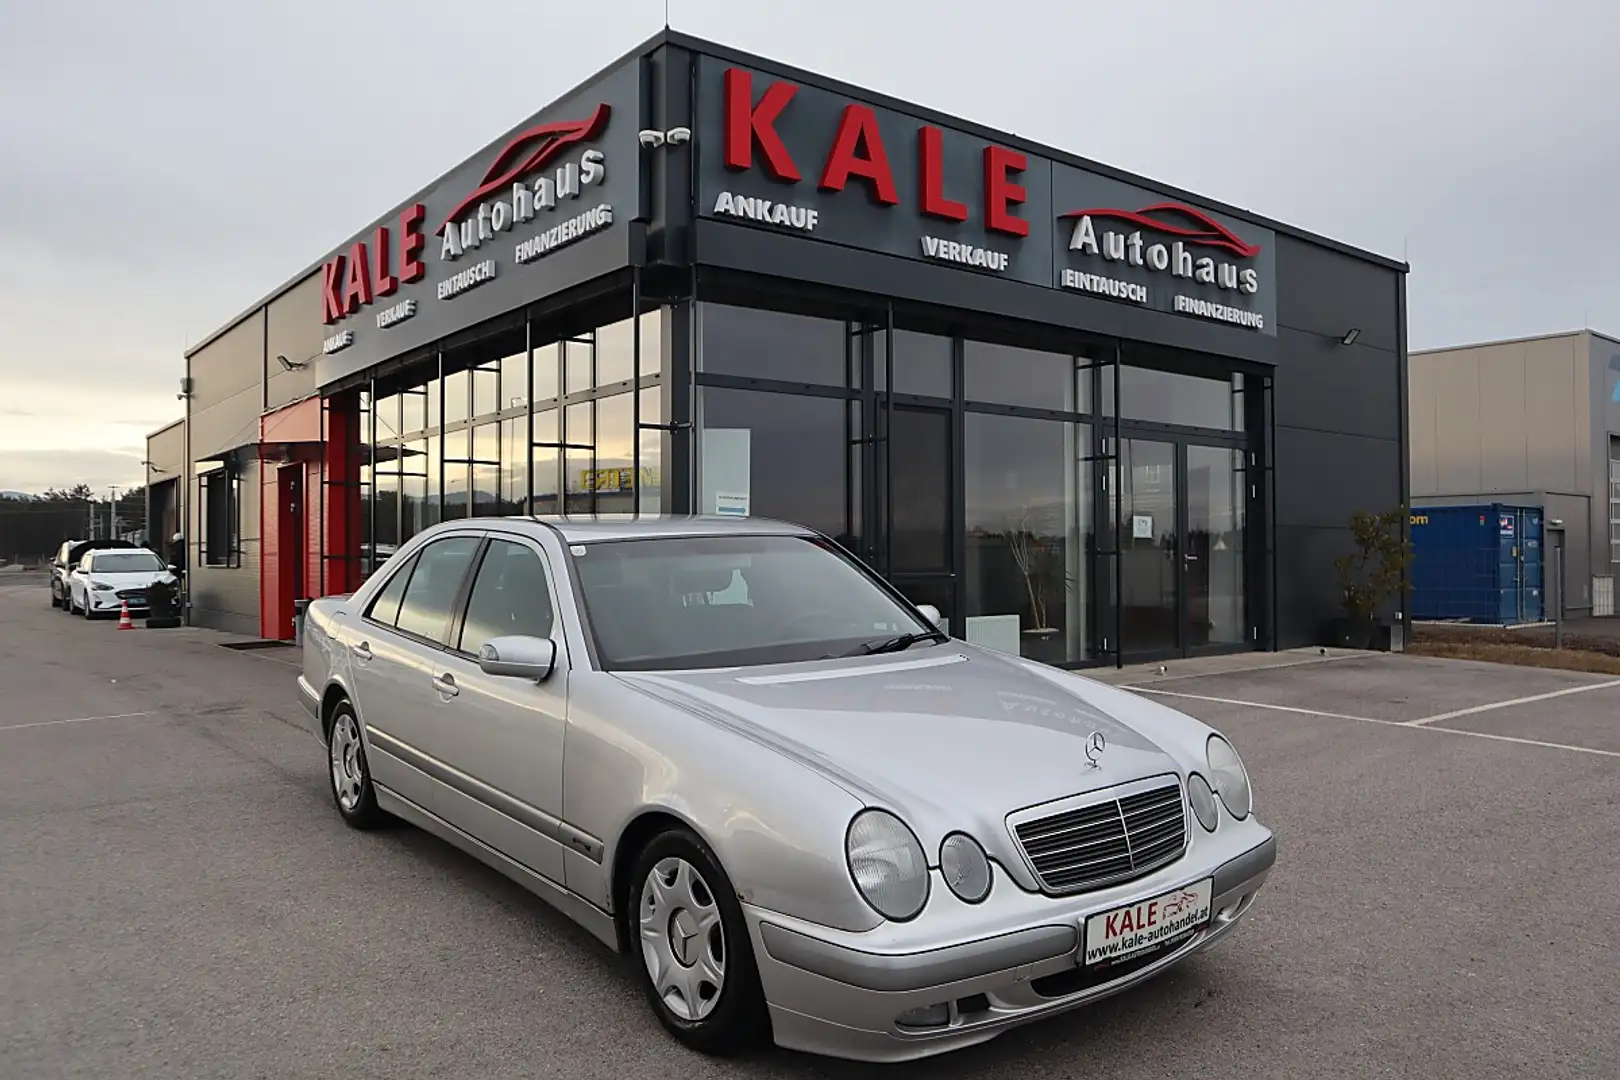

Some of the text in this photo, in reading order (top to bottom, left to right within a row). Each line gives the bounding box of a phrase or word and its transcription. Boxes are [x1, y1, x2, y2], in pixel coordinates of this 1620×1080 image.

[724, 68, 1030, 238] KALE
[440, 150, 605, 260] Autohaus
[714, 191, 818, 231] ANKAUF
[515, 203, 612, 263] FINANZIERUNG
[921, 235, 1009, 271] VERKAUF
[322, 203, 425, 325] KALE
[1069, 215, 1258, 293] Autohaus
[438, 260, 496, 300] EINTAUSCH
[1061, 268, 1147, 302] EINTAUSCH
[376, 299, 416, 329] VERKAUF
[1175, 295, 1264, 329] FINANZIERUNG
[1088, 906, 1208, 960] www.kale-autohandel.at
[1105, 901, 1159, 939] KALE
